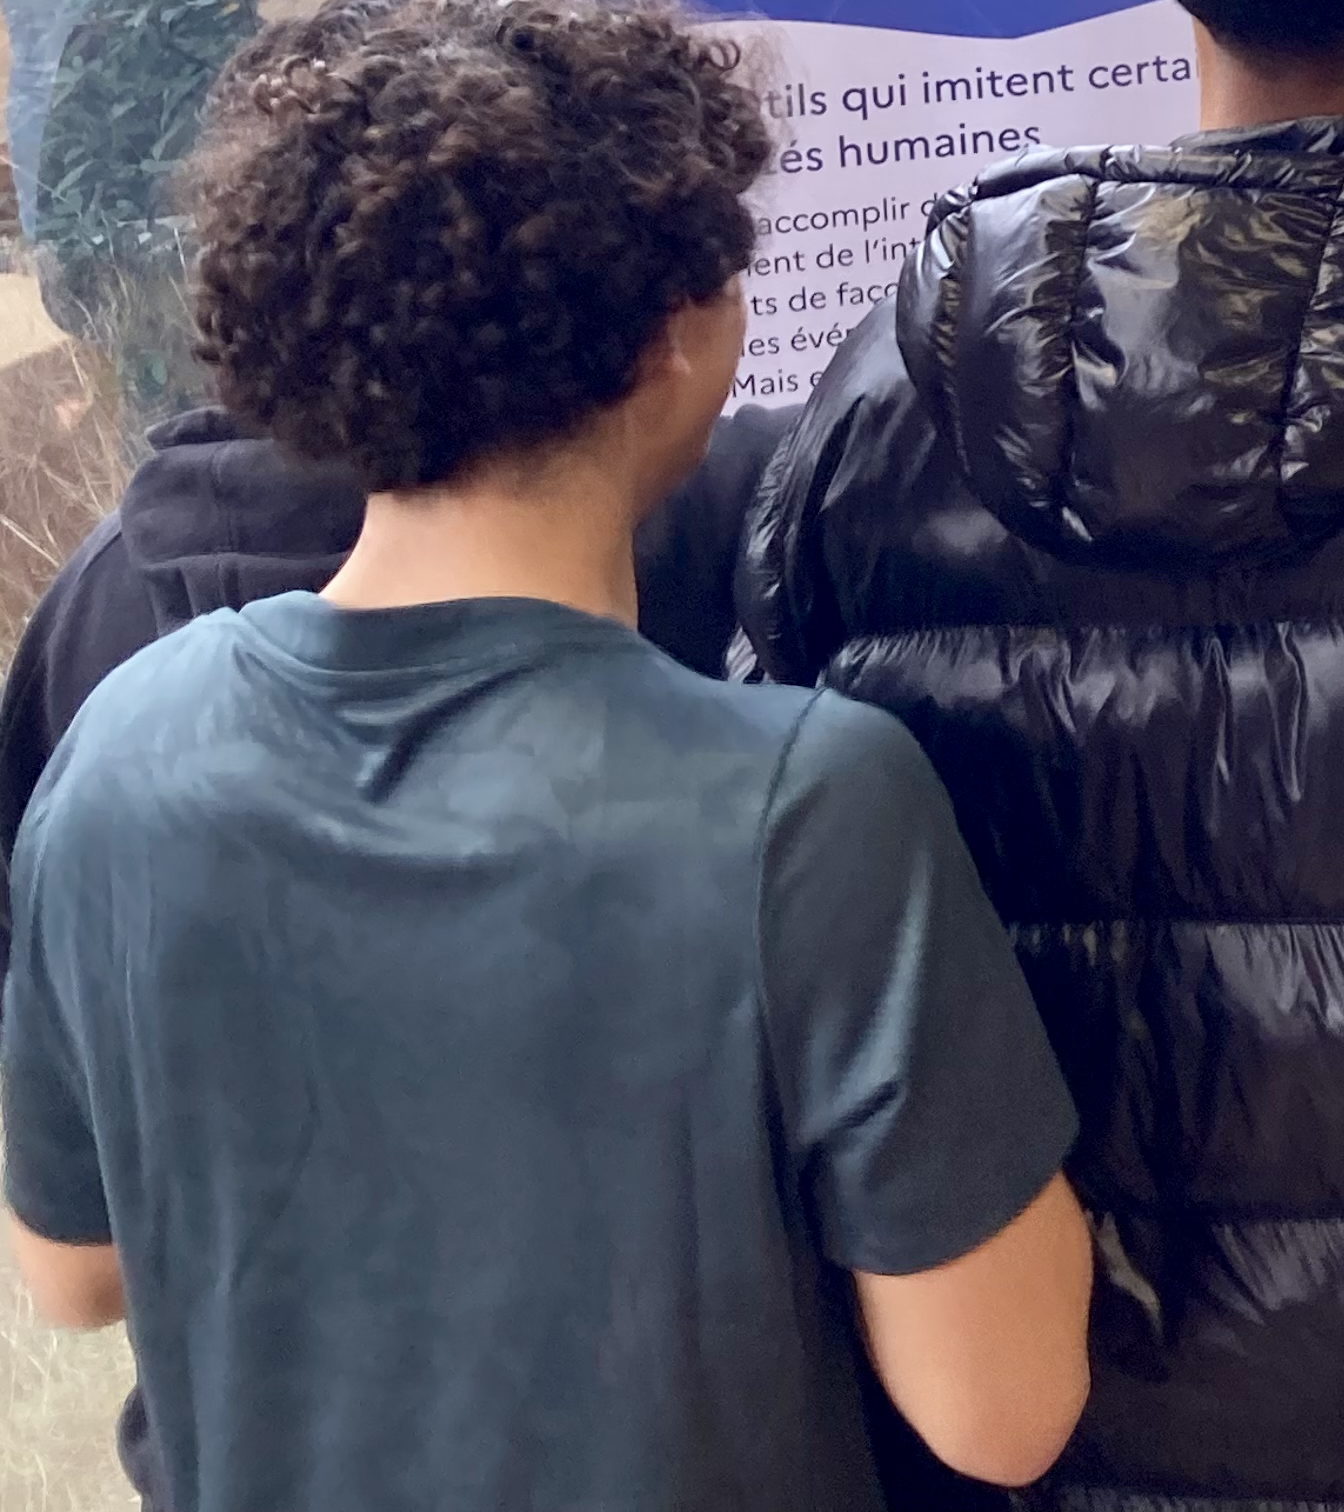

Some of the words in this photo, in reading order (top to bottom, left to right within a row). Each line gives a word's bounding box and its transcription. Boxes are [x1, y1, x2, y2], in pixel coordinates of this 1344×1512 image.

[843, 74, 906, 120] qui
[923, 65, 1074, 103] imitent
[733, 369, 799, 398] Mais
